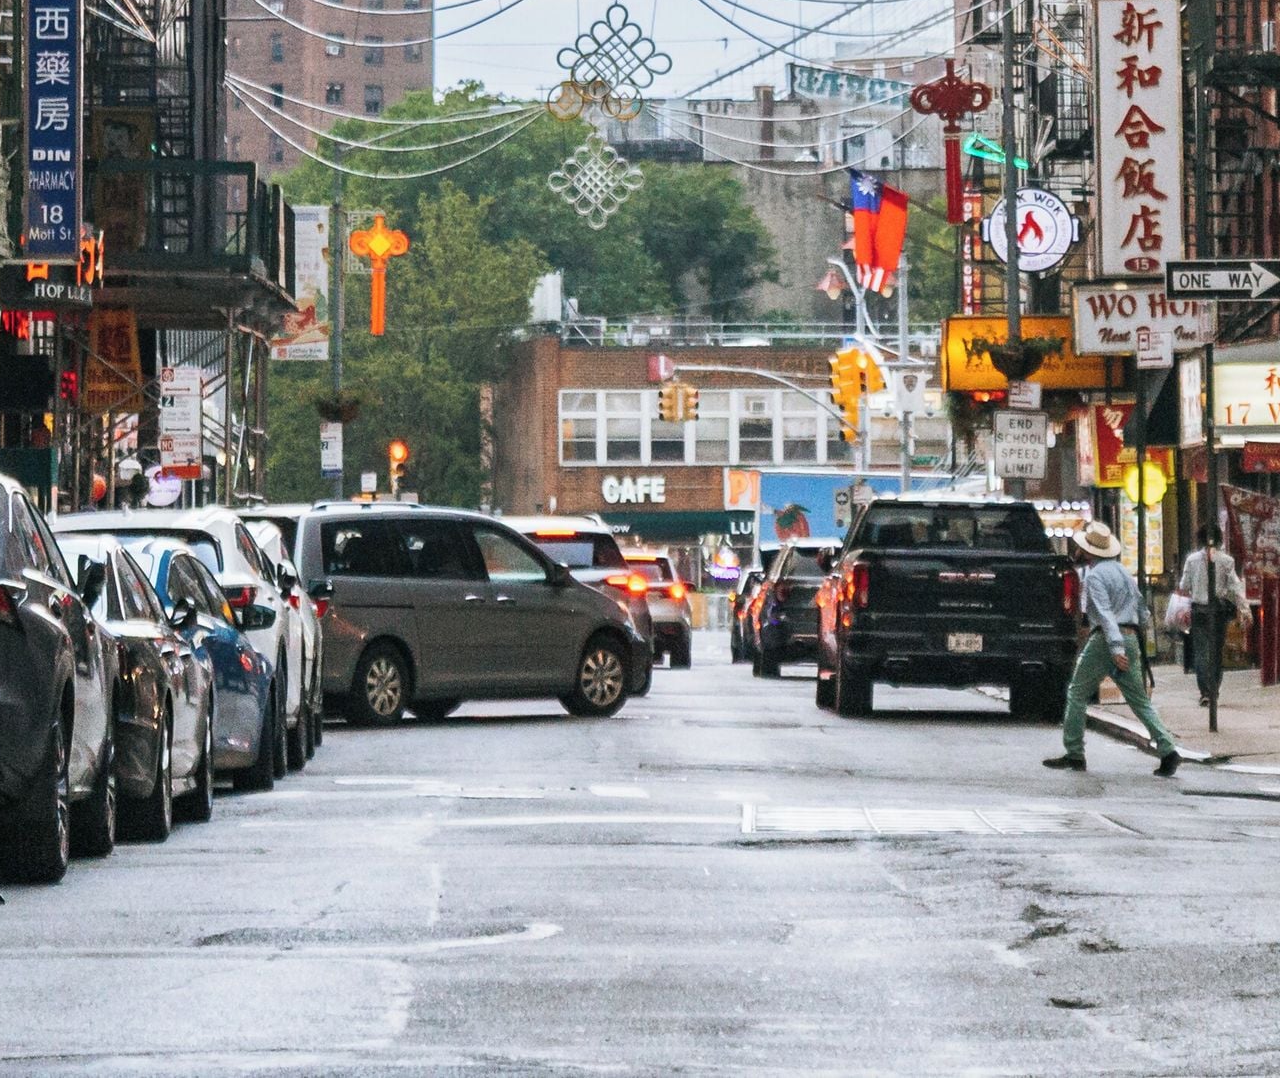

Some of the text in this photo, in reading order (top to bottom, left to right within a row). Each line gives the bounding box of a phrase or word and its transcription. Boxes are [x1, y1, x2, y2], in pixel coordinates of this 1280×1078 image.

[1113, 2, 1168, 252] 新和合飯店
[32, 149, 71, 162] DIN
[29, 170, 75, 190] PHARMACY
[1034, 192, 1063, 216] WOK
[41, 205, 64, 224] 18
[28, 226, 56, 241] Mott
[1134, 259, 1150, 270] 15
[1179, 272, 1264, 289] ONE WAY
[34, 283, 64, 299] HOP
[1086, 293, 1137, 320] WO
[1225, 403, 1251, 425] 17
[1009, 419, 1033, 429] END
[997, 433, 1045, 444] SCHOOL
[1001, 449, 1040, 459] SPEED
[1005, 463, 1034, 473] LIMIT
[601, 475, 666, 504] CAFE
